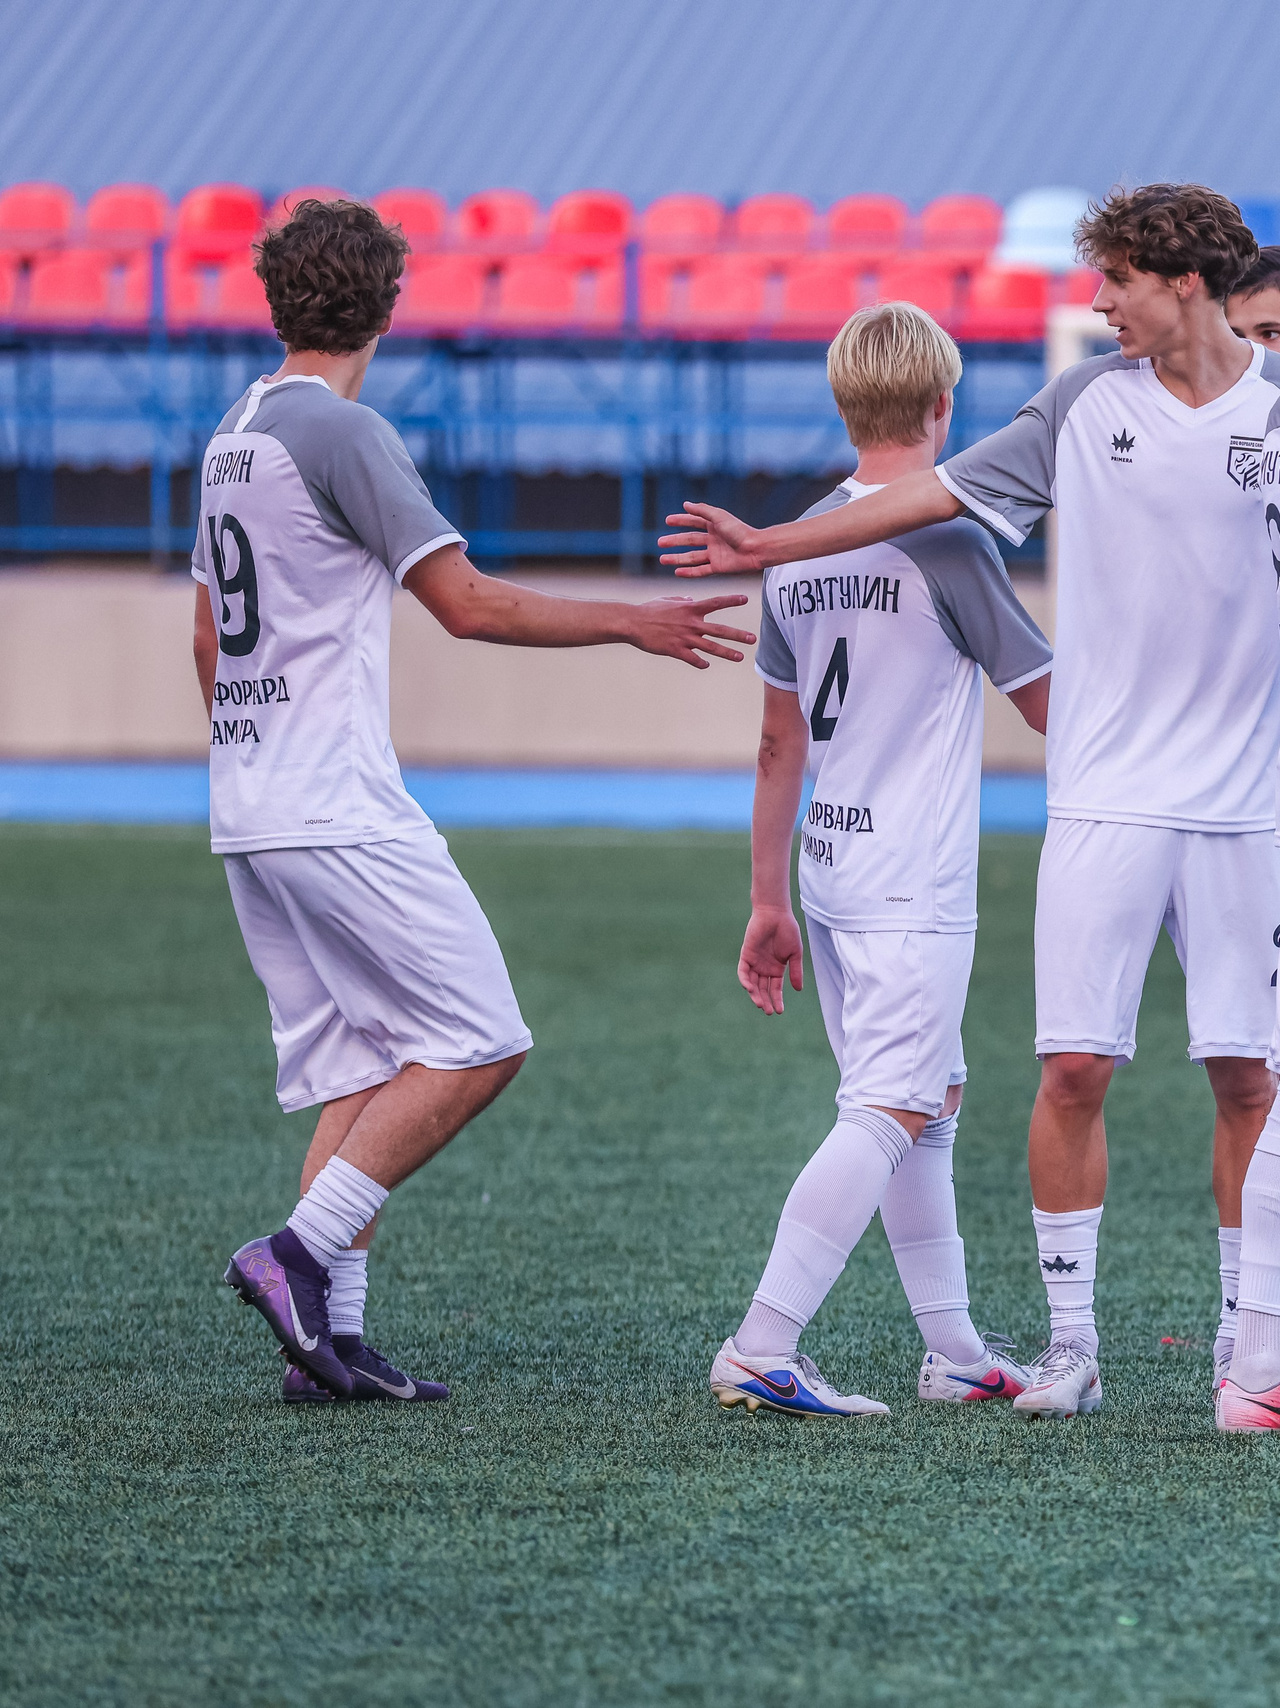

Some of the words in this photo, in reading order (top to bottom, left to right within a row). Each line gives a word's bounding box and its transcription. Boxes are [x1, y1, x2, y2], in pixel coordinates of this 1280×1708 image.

[206, 450, 255, 487] СУРИН
[1110, 455, 1133, 463] PRIMERA
[778, 575, 901, 620] ГИЗАТУЛИН
[810, 637, 850, 741] 4
[808, 800, 874, 833] ОРВАРД
